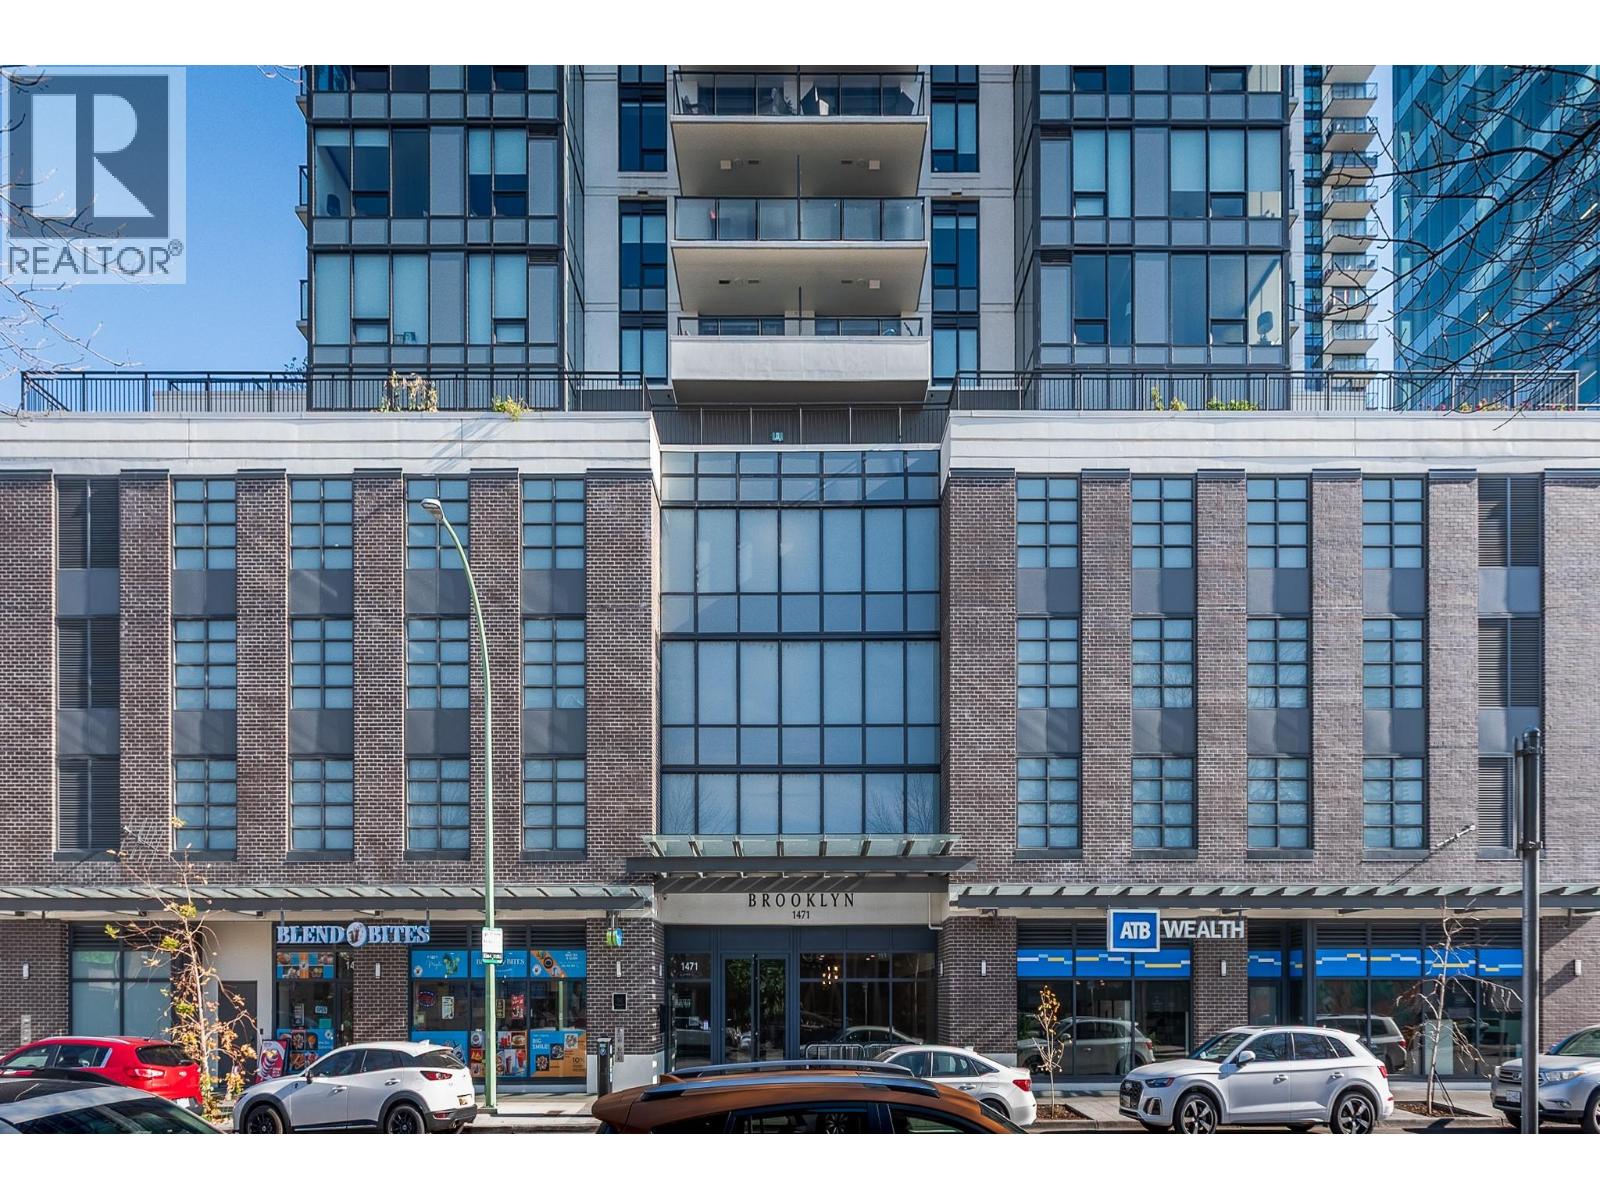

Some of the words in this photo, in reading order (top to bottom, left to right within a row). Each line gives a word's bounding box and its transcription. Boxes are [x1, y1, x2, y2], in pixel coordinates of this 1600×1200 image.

[748, 893, 854, 907] BROOKLYN
[792, 910, 810, 919] 1471
[277, 926, 345, 944] BLEND
[367, 926, 430, 944] BITES
[1120, 921, 1151, 939] ATB
[1163, 920, 1244, 938] WEALTH
[680, 961, 698, 971] 1471
